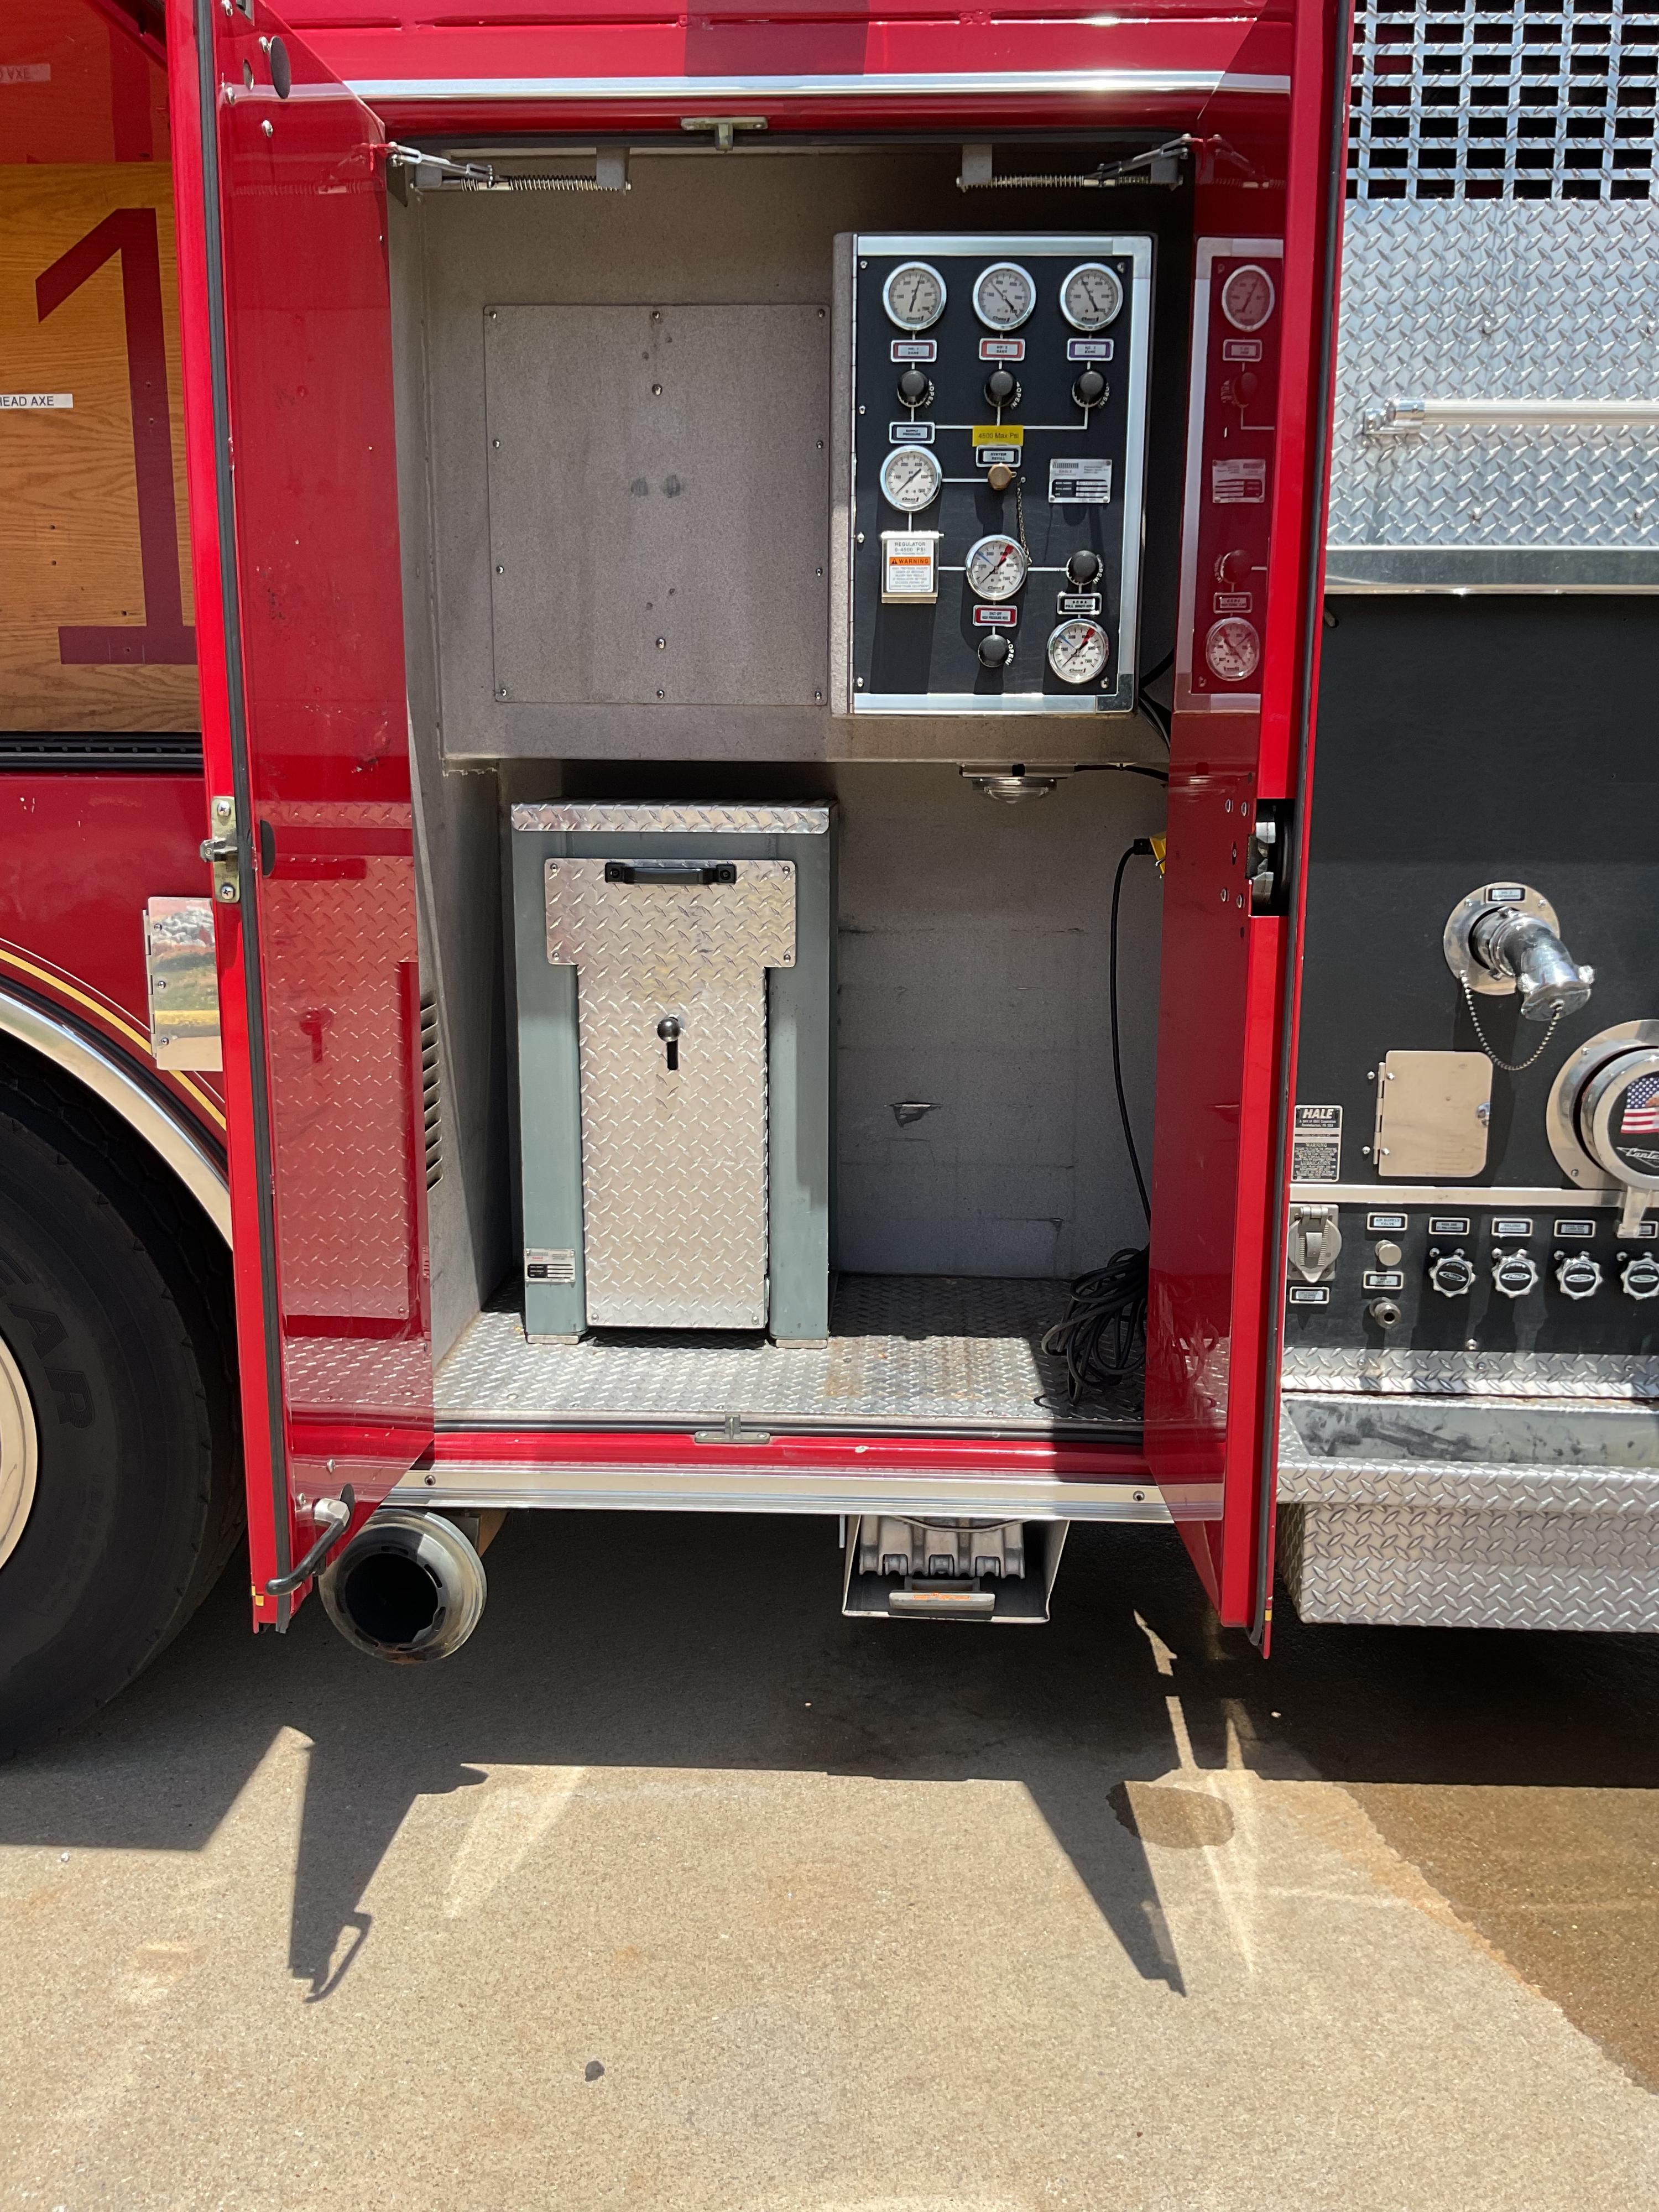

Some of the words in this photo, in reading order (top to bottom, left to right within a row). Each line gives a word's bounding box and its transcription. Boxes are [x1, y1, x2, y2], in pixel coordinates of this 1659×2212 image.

[0, 397, 27, 406] EAD
[31, 396, 54, 406] AXE
[926, 386, 935, 406] OPEN
[1013, 388, 1021, 407] OPEN
[35, 208, 197, 664] 1
[1006, 644, 1014, 664] OPEN
[1303, 1109, 1334, 1119] HALE
